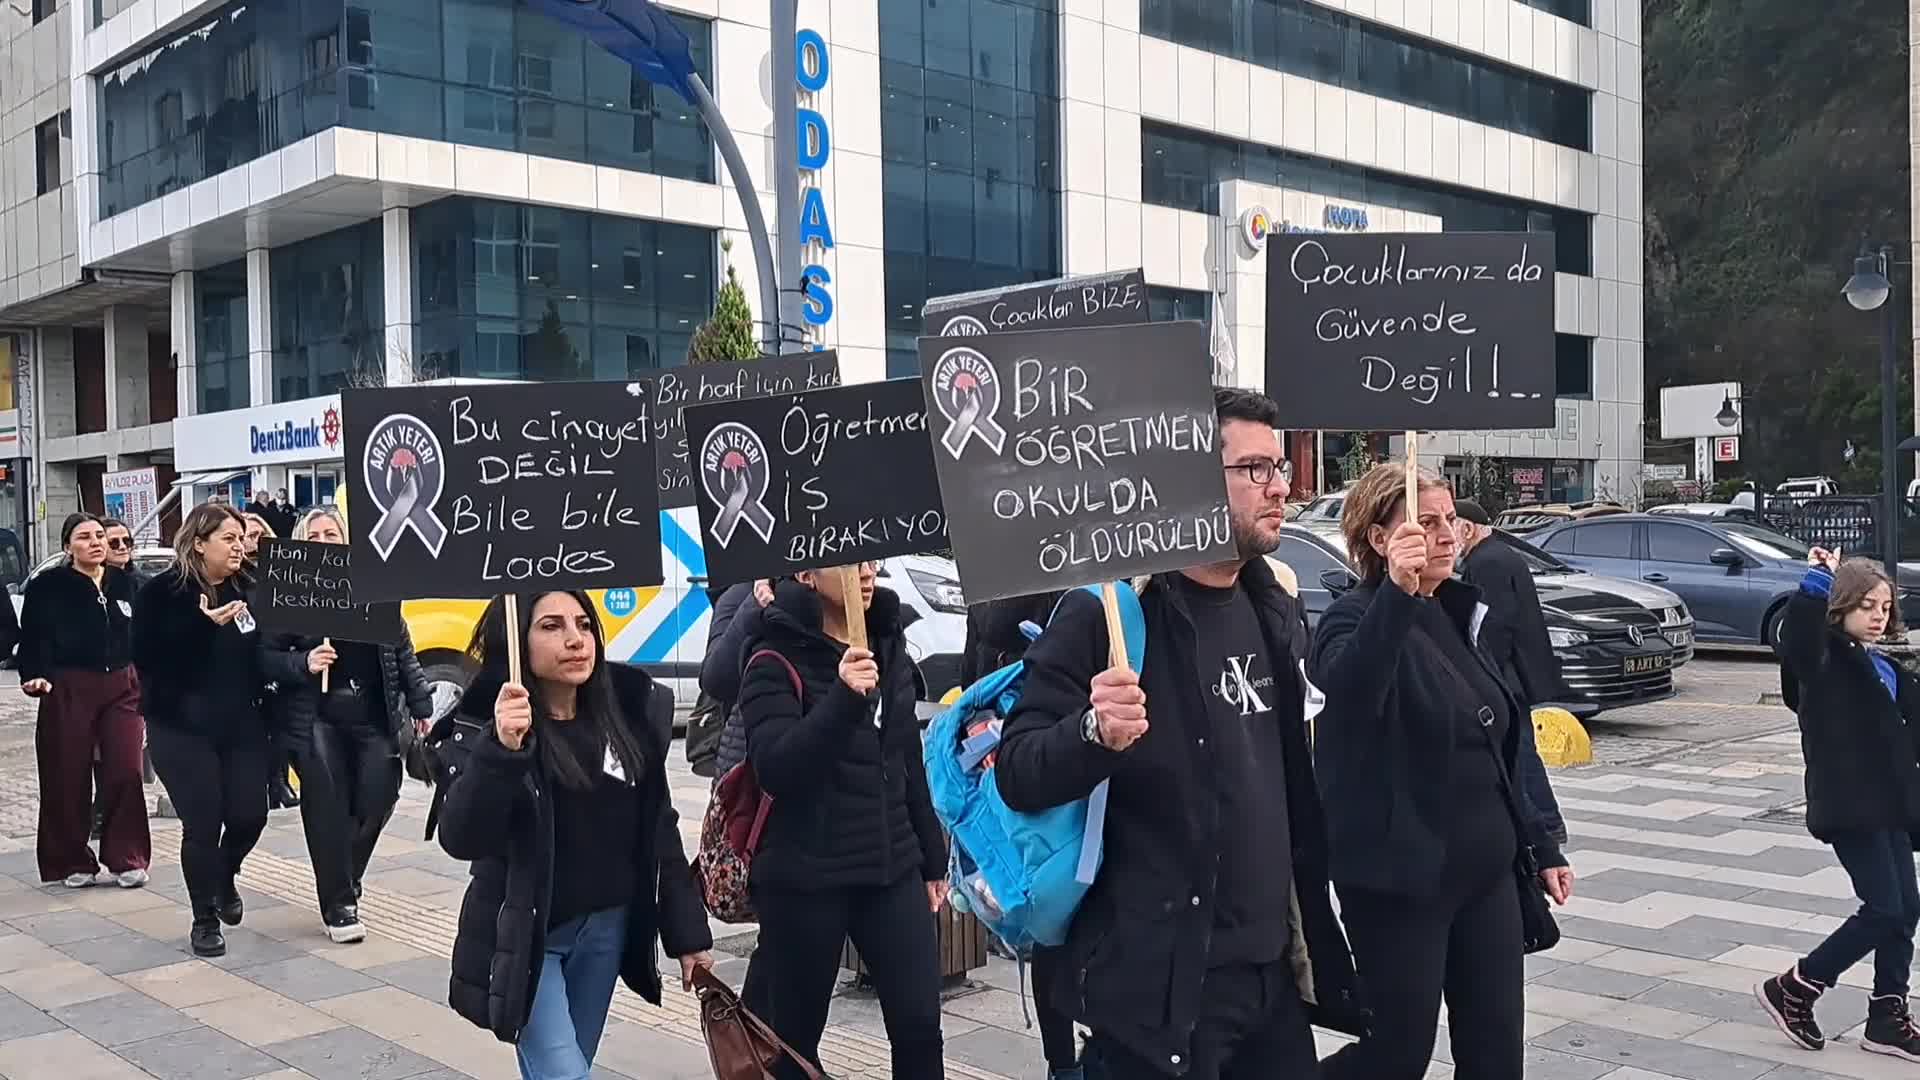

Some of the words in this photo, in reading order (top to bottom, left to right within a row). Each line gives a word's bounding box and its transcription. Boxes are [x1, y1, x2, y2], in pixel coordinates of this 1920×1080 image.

[796, 28, 834, 351] ODAS
[1507, 243, 1543, 283] da
[1315, 300, 1477, 342] Güvende
[657, 373, 690, 406] Bir
[698, 368, 748, 400] harf
[1012, 357, 1094, 422] BİR
[250, 417, 321, 454] DenizBank
[449, 396, 501, 445] Bu
[1014, 411, 1214, 470] ÖĞRETMEN
[1720, 442, 1733, 456] E
[451, 494, 536, 535] Bile
[561, 487, 641, 530] bile
[992, 477, 1158, 519] OKULDA
[269, 543, 308, 562] Hani
[1038, 505, 1231, 573] ÖLDÜRÜLDÜ
[481, 543, 616, 580] Lades
